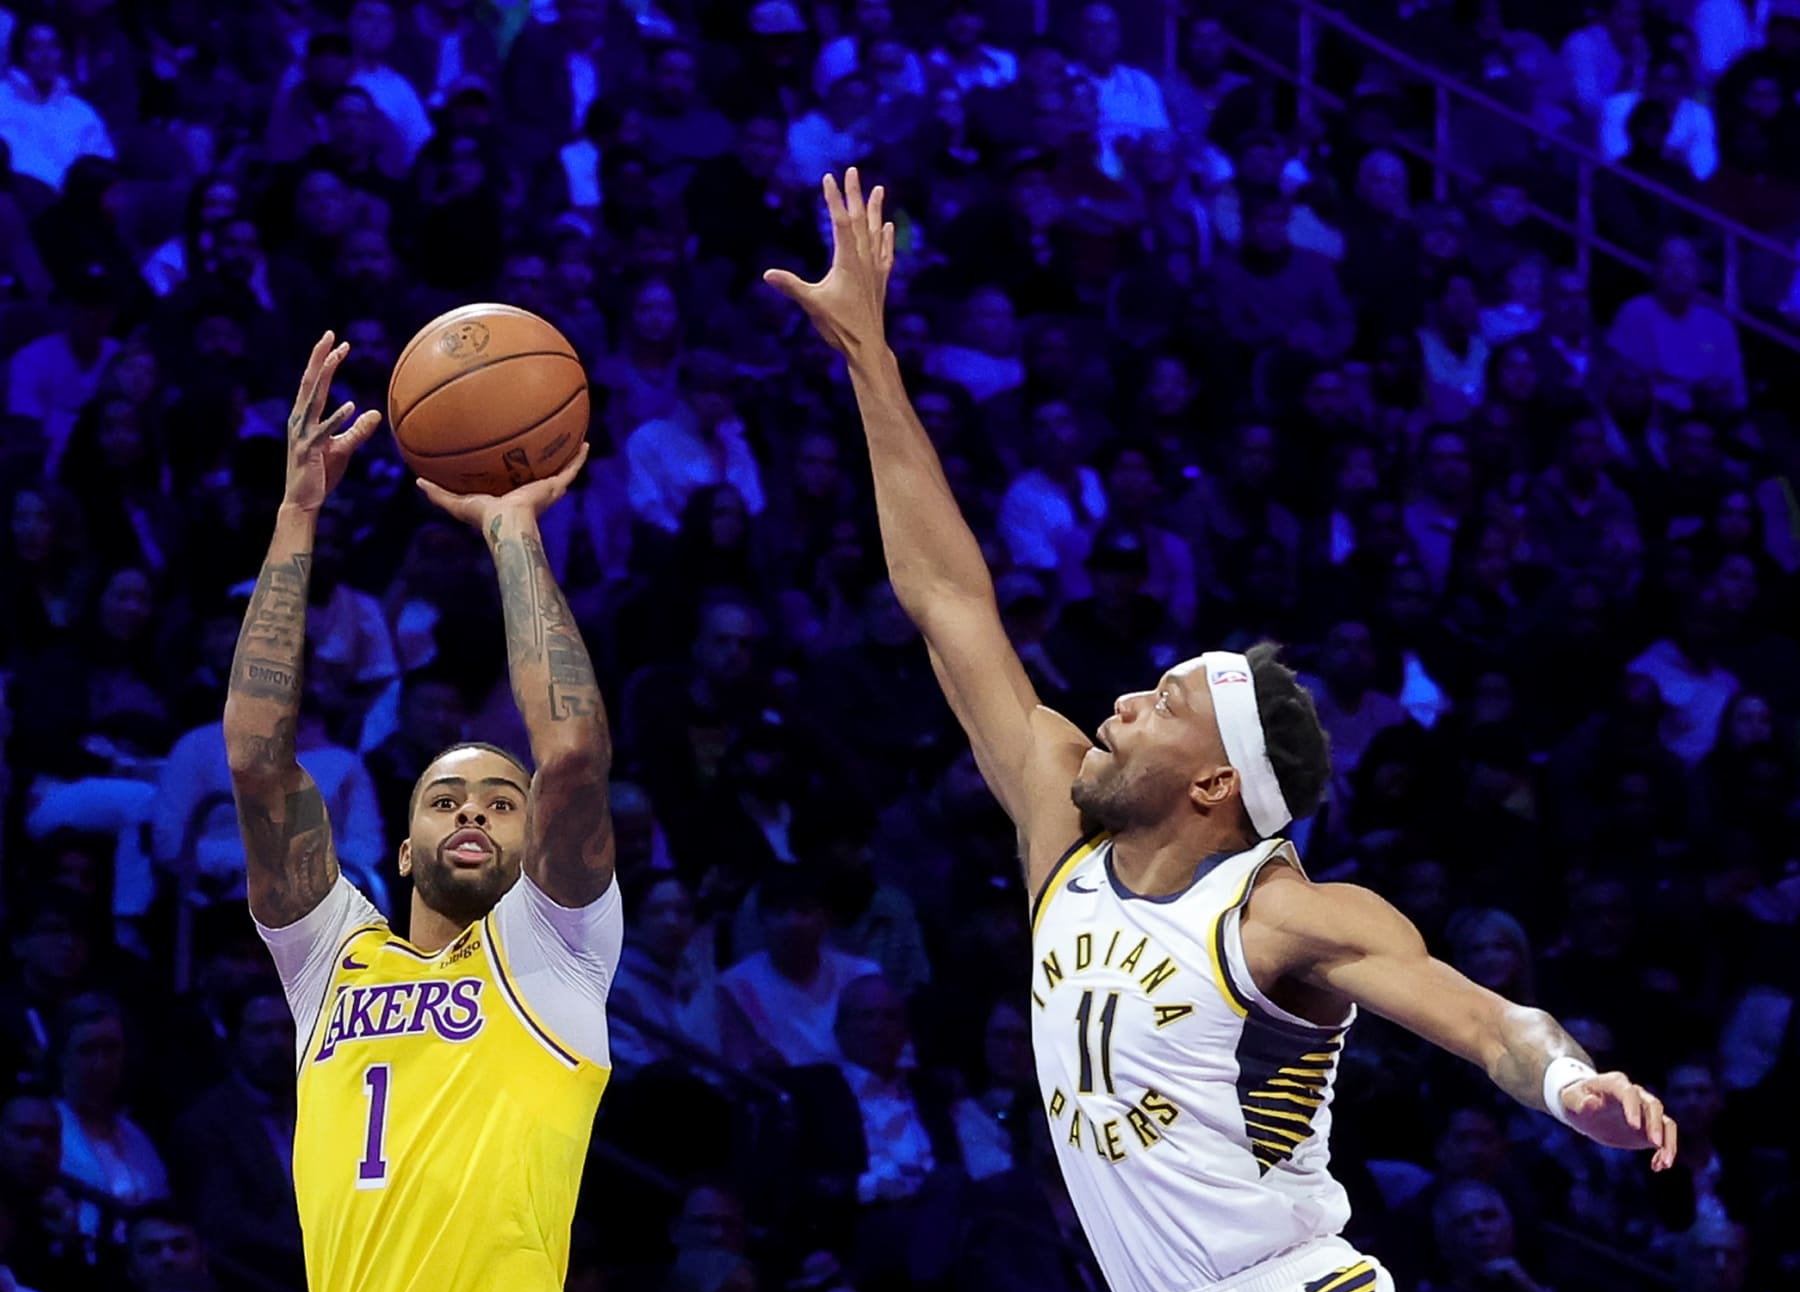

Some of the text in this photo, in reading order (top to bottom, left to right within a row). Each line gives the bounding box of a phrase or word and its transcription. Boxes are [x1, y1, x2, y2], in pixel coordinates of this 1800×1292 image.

[1032, 930, 1194, 1028] INDIANA
[1075, 990, 1121, 1096] 11
[355, 1063, 391, 1190] 1
